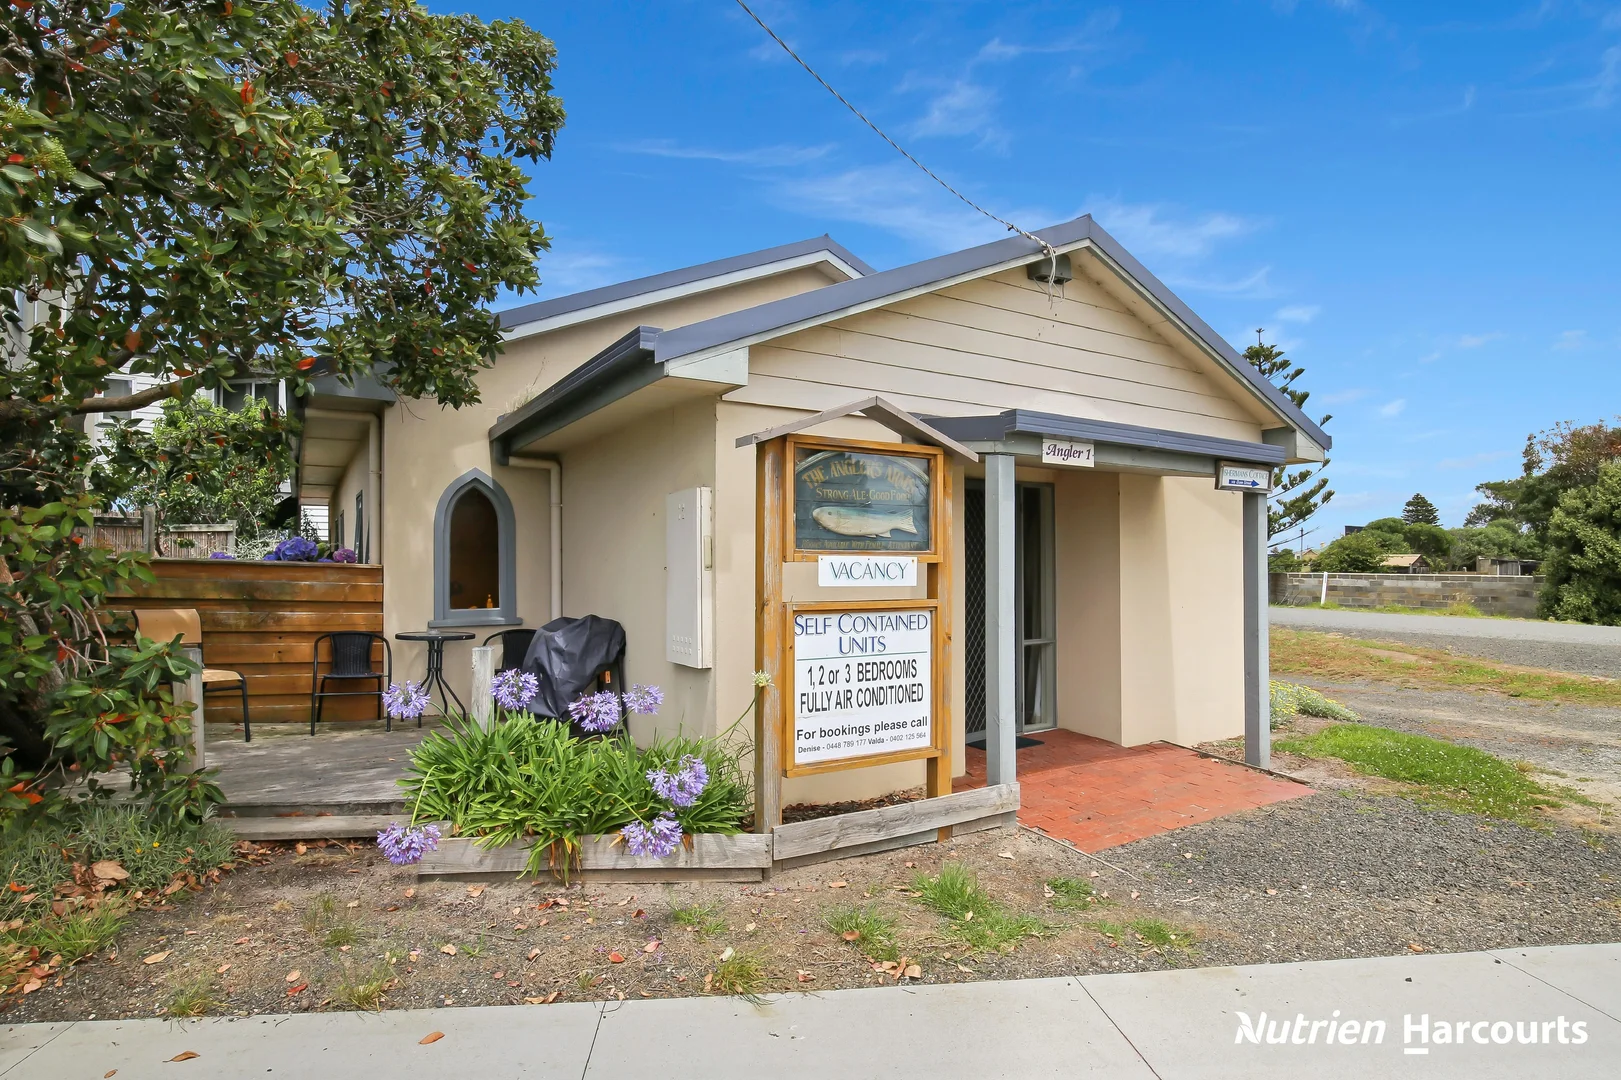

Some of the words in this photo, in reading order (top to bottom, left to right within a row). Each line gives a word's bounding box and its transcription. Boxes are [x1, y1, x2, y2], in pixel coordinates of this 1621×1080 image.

[1046, 444, 1083, 461] Angler
[1086, 448, 1092, 460] 1
[802, 465, 828, 489] THE
[815, 487, 849, 502] STRONG
[850, 488, 866, 501] ALE
[869, 489, 891, 501] GOOD
[830, 561, 909, 581] VACANCY
[794, 614, 832, 637] SELF
[838, 612, 928, 635] CONTAINED
[838, 635, 887, 655] UNITS
[828, 668, 840, 685] or
[845, 663, 851, 684] 3
[857, 658, 918, 683] BEDROOMS
[800, 690, 833, 714] FULLY
[834, 689, 853, 710] AIR
[856, 683, 924, 708] CONDITIONED
[796, 729, 817, 741] For
[819, 724, 871, 738] bookings
[874, 721, 908, 734] please
[910, 716, 928, 728] call
[798, 745, 821, 754] Denise
[826, 742, 841, 750] 0448
[843, 740, 854, 748] 789
[867, 737, 885, 745] Valda
[889, 735, 903, 743] 0402
